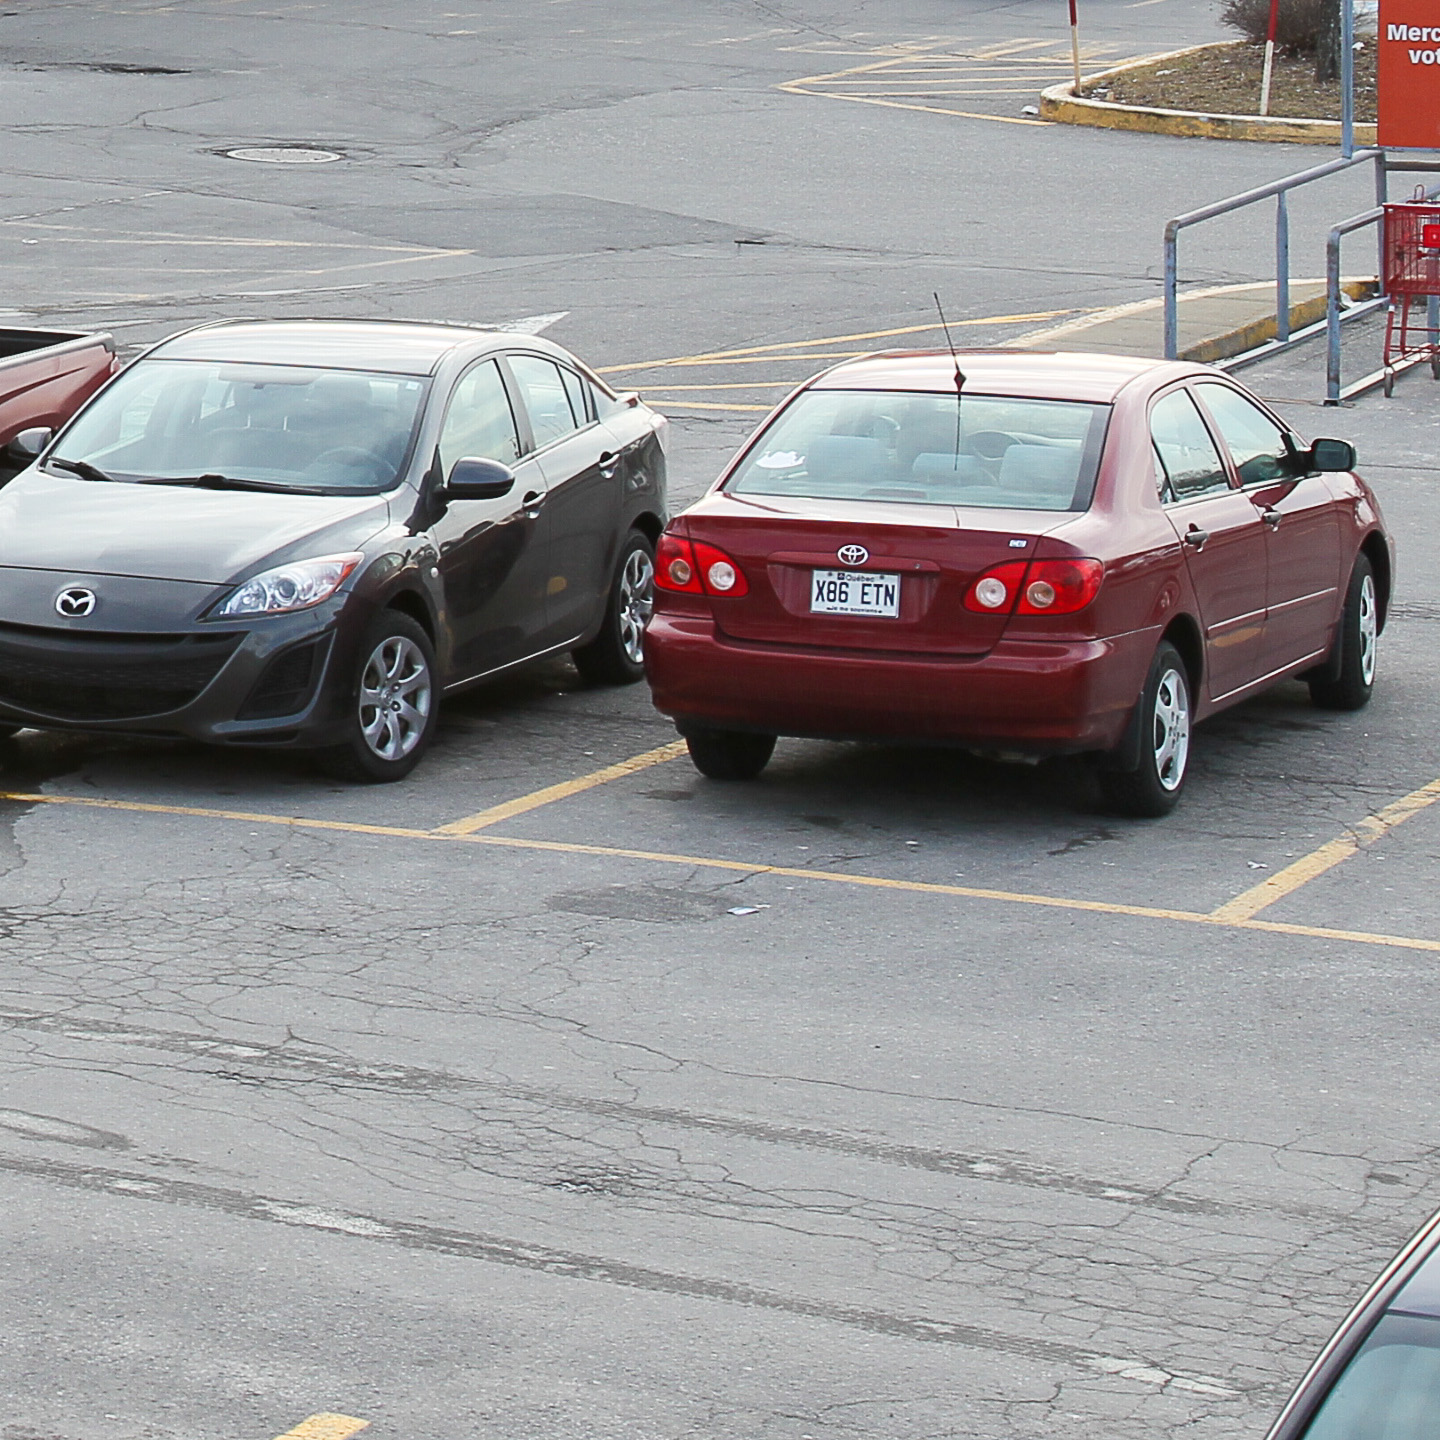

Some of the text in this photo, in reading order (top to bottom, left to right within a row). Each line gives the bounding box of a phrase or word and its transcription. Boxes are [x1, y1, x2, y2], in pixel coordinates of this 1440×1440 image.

[1387, 24, 1440, 42] Merc
[845, 574, 875, 582] Québec
[815, 579, 895, 606] X86 ETN
